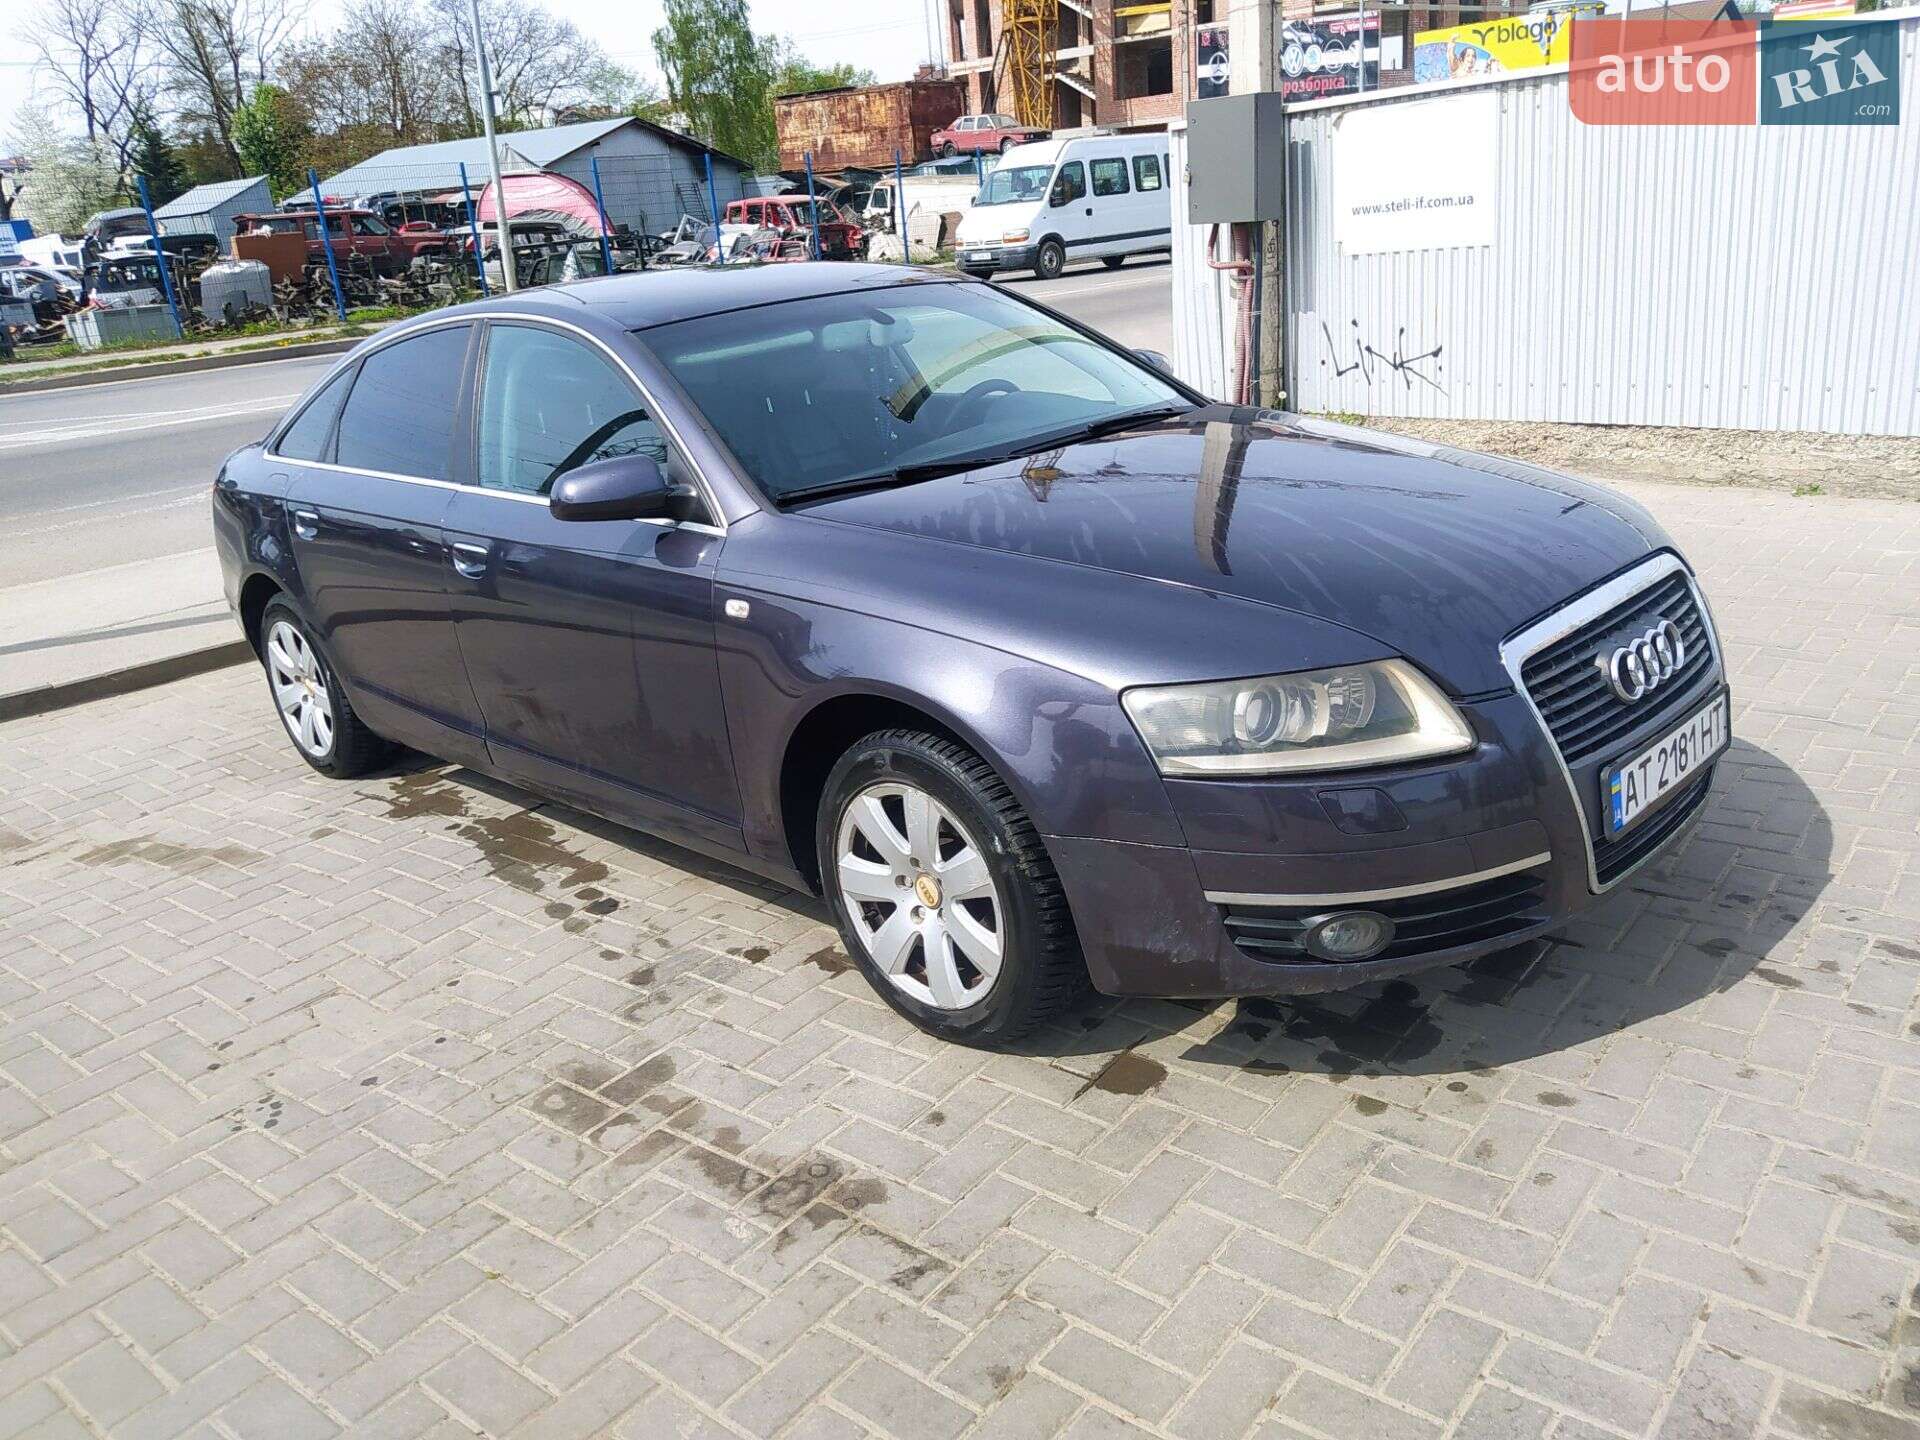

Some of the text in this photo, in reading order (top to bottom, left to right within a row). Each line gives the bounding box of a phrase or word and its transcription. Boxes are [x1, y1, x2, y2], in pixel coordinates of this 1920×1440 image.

[1497, 20, 1557, 43] blago
[1283, 75, 1345, 98] розборка
[1351, 195, 1474, 216] www.steli-if.com.ua
[1625, 701, 1723, 817] AT 2181 HT
